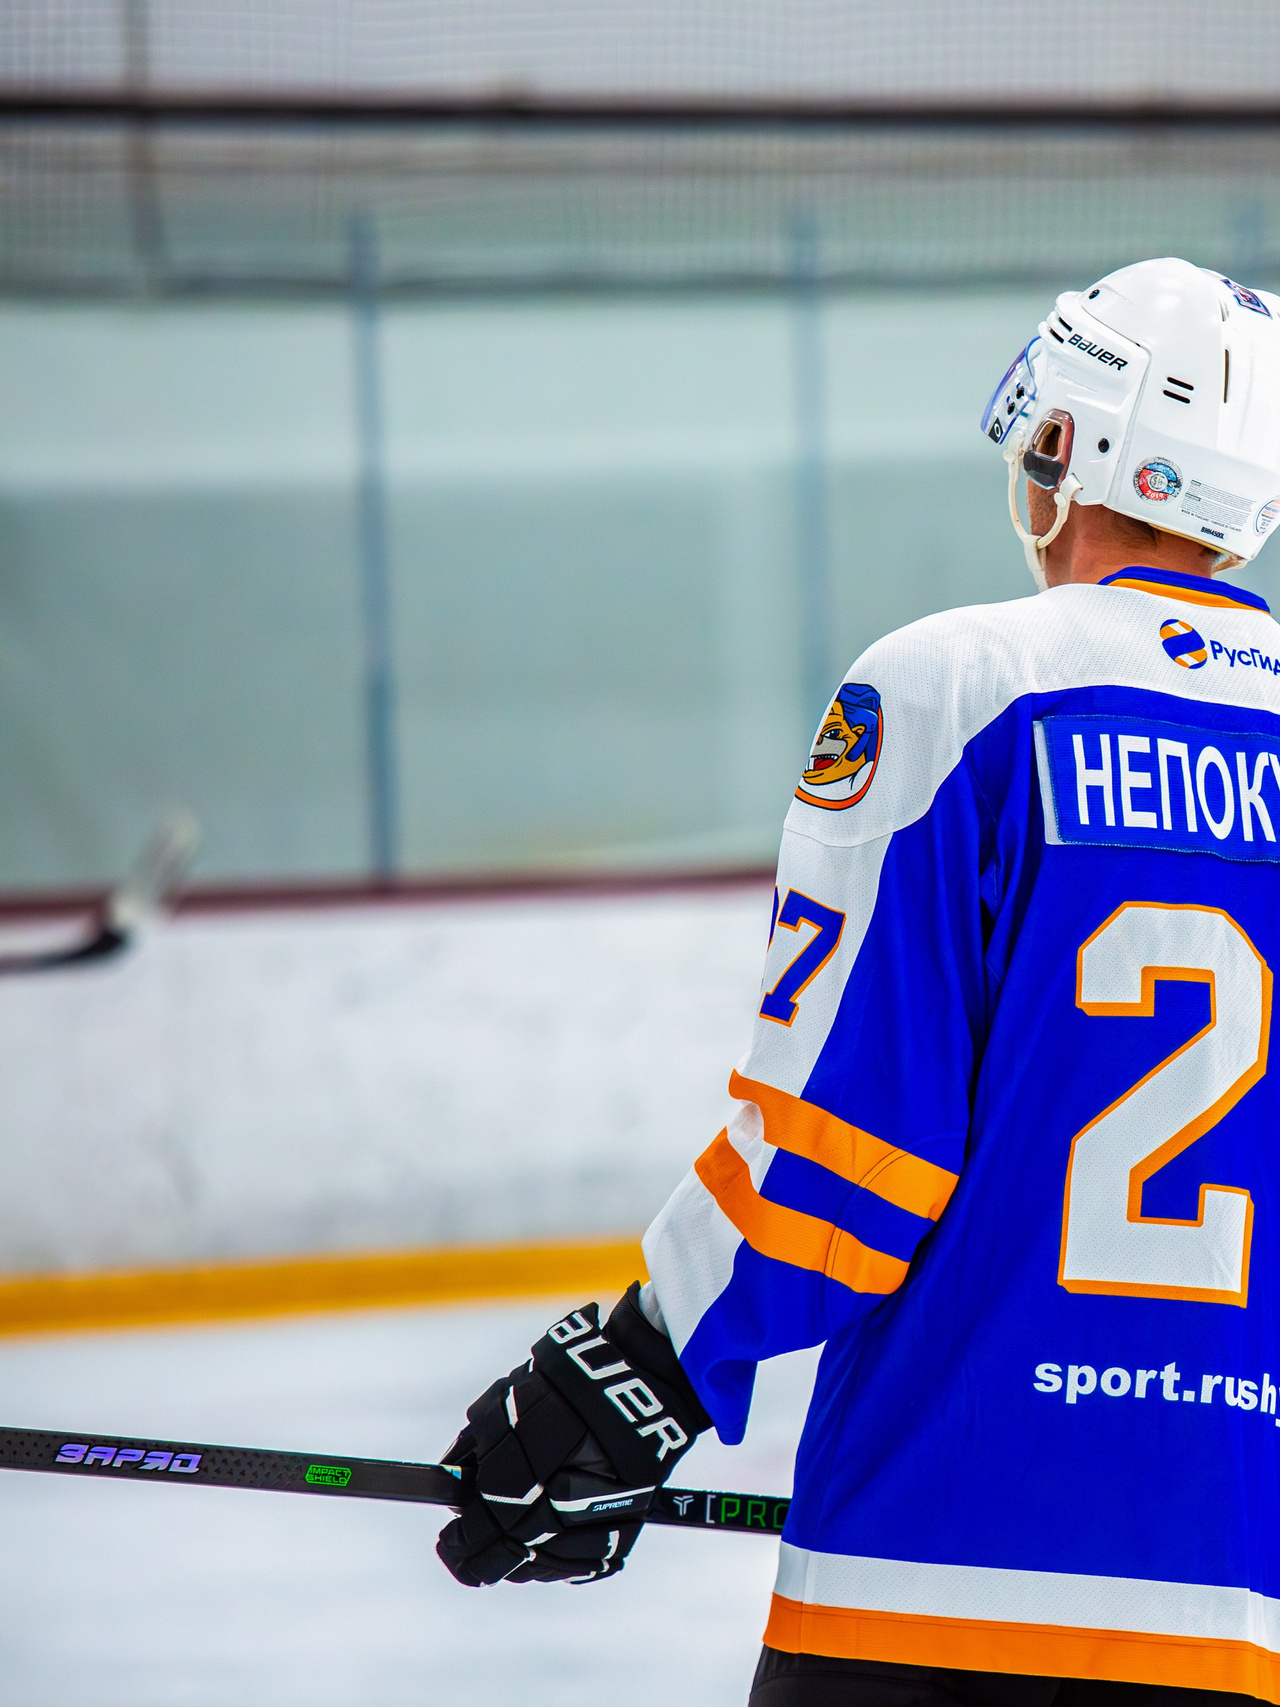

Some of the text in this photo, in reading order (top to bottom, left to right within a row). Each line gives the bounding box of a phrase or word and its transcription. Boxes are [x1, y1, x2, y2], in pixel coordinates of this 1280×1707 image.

[759, 885, 847, 1028] 7
[548, 1311, 689, 1463] AUER
[306, 1474, 348, 1484] SHIELD
[309, 1467, 350, 1477] IMPACT
[592, 1498, 634, 1512] SUPREME
